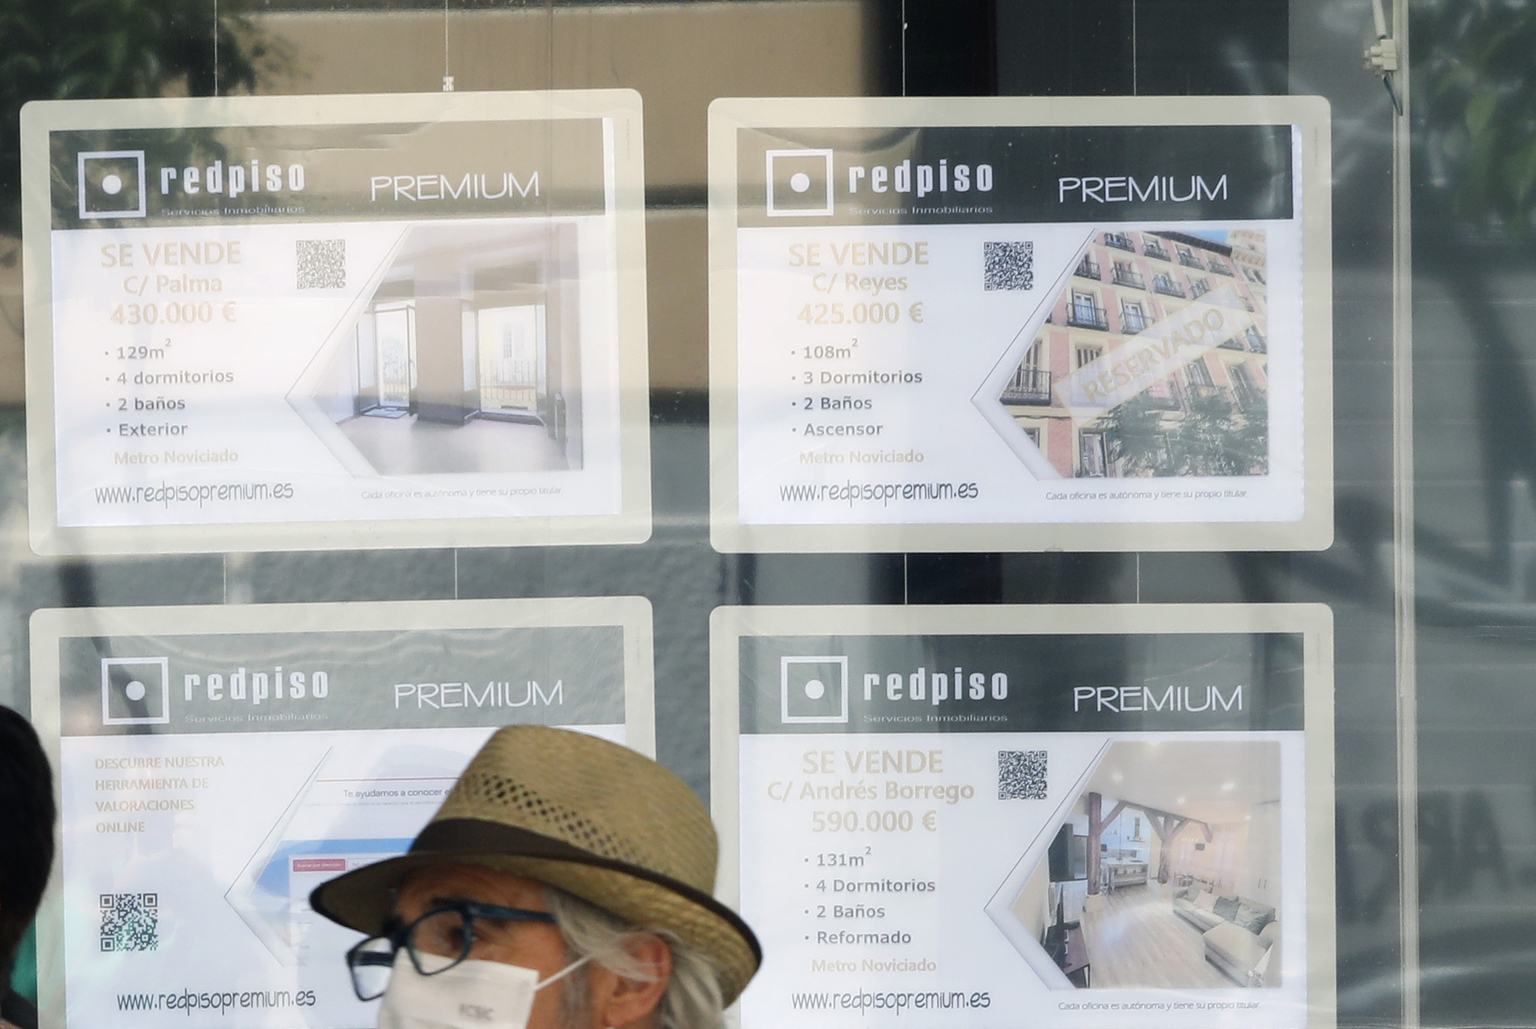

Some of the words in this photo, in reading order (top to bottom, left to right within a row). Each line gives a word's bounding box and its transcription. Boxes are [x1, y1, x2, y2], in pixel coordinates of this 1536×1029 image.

[161, 159, 305, 198] redpiso
[371, 171, 539, 200] PREMIUM
[849, 159, 993, 198] redpiso
[1059, 175, 1228, 203] PREMIUM
[101, 245, 136, 267] SE
[144, 242, 241, 265] VENDE
[789, 243, 824, 266] SE
[830, 242, 929, 265] VENDE
[124, 274, 148, 295] C/
[156, 274, 223, 294] Palma
[812, 272, 836, 293] C/
[845, 273, 907, 294] Reyes
[111, 303, 212, 326] 430.000
[222, 301, 237, 323] €
[797, 303, 899, 325] 425.000
[908, 302, 923, 324] €
[1082, 307, 1225, 403] RESERVADO
[117, 372, 127, 384] 4
[134, 369, 234, 385] dormitorios
[804, 371, 813, 384] 3
[820, 370, 922, 385] Dormitorios
[119, 398, 128, 411] 2
[135, 396, 185, 411] baños
[804, 397, 814, 410] 2
[821, 395, 872, 410] Baños
[119, 423, 188, 437] Exterior
[803, 422, 883, 437] Ascensor
[95, 481, 293, 508] www.redpisopremium.es
[779, 480, 979, 507] www.redpisopremium.es
[185, 666, 329, 704] redpiso
[395, 680, 564, 709] PREMIUM
[864, 666, 1008, 704] redpiso
[1074, 686, 1242, 711] PREMIUM
[864, 714, 922, 723] Servicios
[927, 714, 1007, 722] Inmobiliarios
[95, 756, 161, 770] DESCUBRE
[165, 755, 224, 769] NUESTRA
[803, 751, 837, 774] SE
[845, 750, 943, 773] VENDE
[95, 777, 188, 791] HERRAMIENTA
[192, 777, 209, 790] DE
[768, 781, 793, 802] C/
[800, 780, 877, 800] Andrés
[885, 782, 974, 805] Borrego
[95, 799, 194, 813] VALORACIONES
[96, 821, 145, 834] ONLINE
[812, 810, 913, 833] 590.000
[922, 810, 937, 831] €
[817, 880, 826, 892] 4
[833, 878, 935, 893] Dormitorios
[817, 905, 826, 918] 2
[833, 904, 885, 919] Baños
[817, 930, 911, 944] Reformado
[812, 958, 857, 972] Metro
[862, 958, 937, 972] Noviciado
[117, 990, 316, 1015] www.redpisopremium.es
[791, 988, 990, 1015] www.redpisopremium.es
